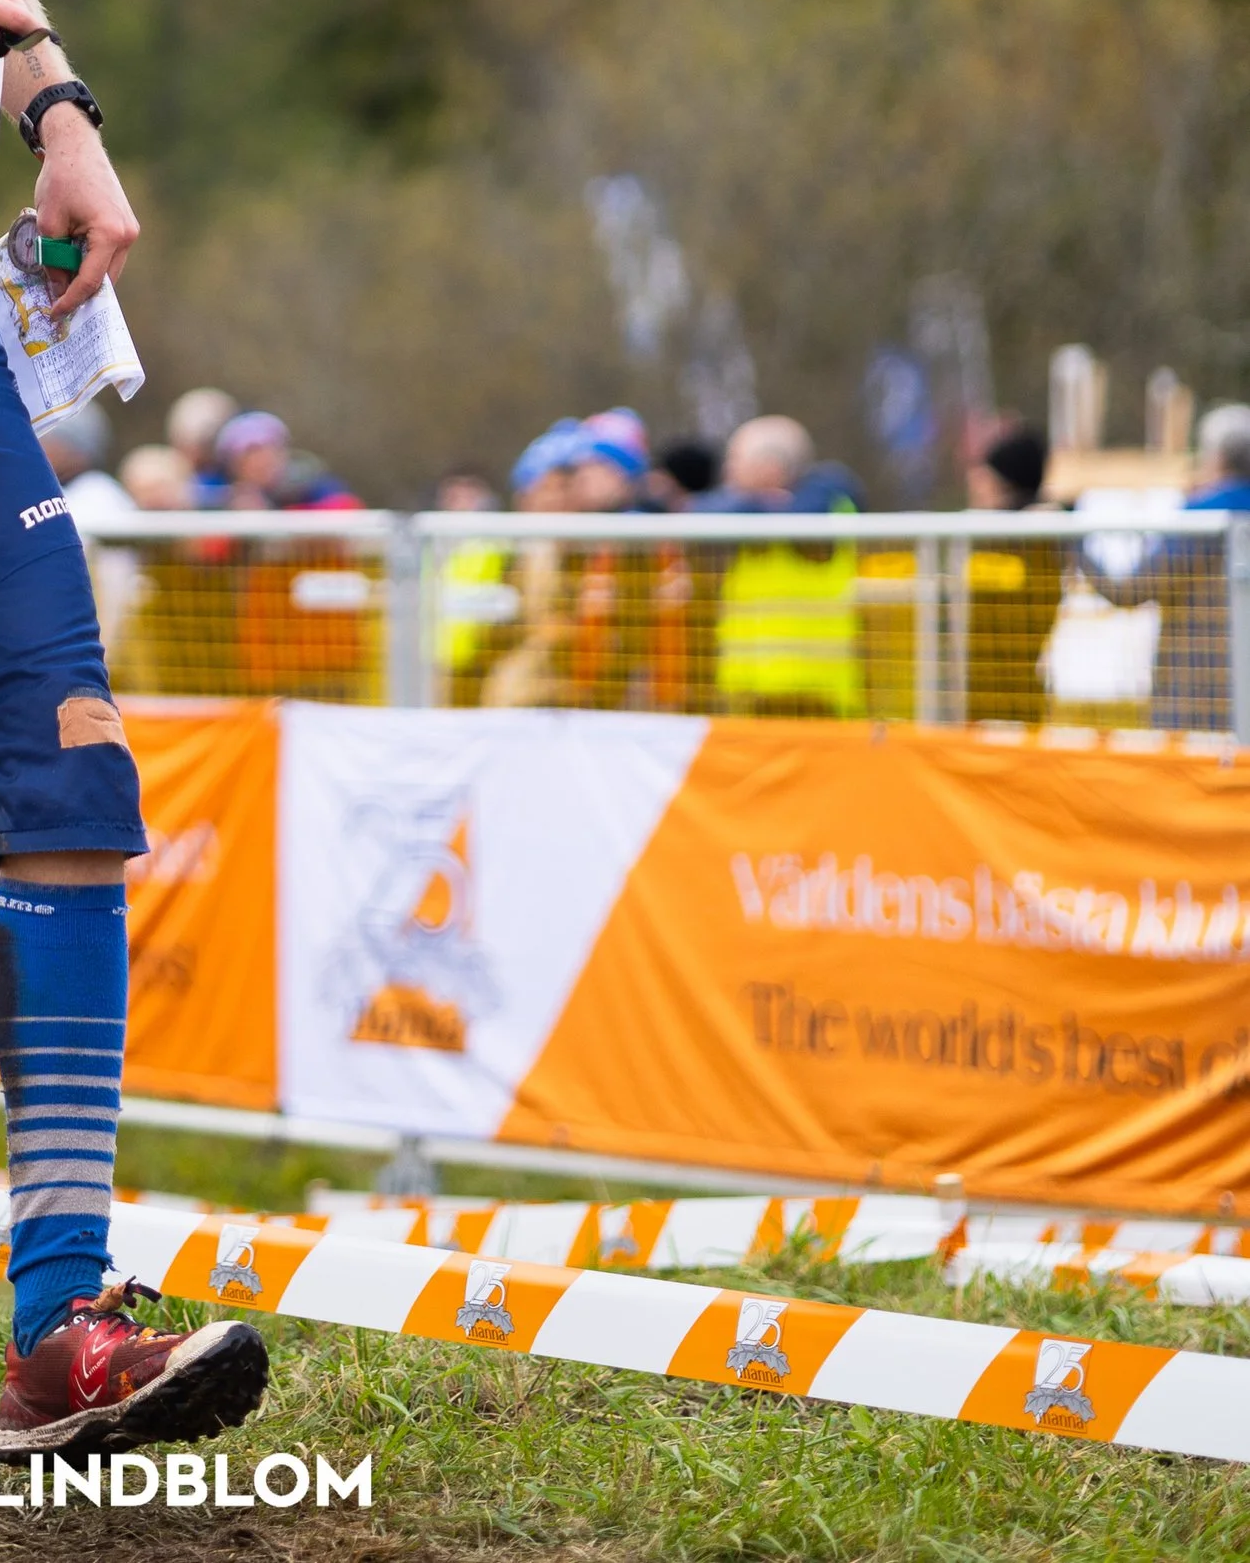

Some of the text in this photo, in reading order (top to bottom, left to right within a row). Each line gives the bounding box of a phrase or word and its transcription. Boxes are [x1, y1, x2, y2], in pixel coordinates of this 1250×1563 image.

[744, 981, 848, 1059] The
[1060, 1010, 1186, 1096] best
[469, 1263, 507, 1309] 25
[742, 1302, 782, 1349] 25
[740, 1367, 782, 1384] manna
[1042, 1343, 1085, 1393] 25
[1040, 1412, 1085, 1430] manna
